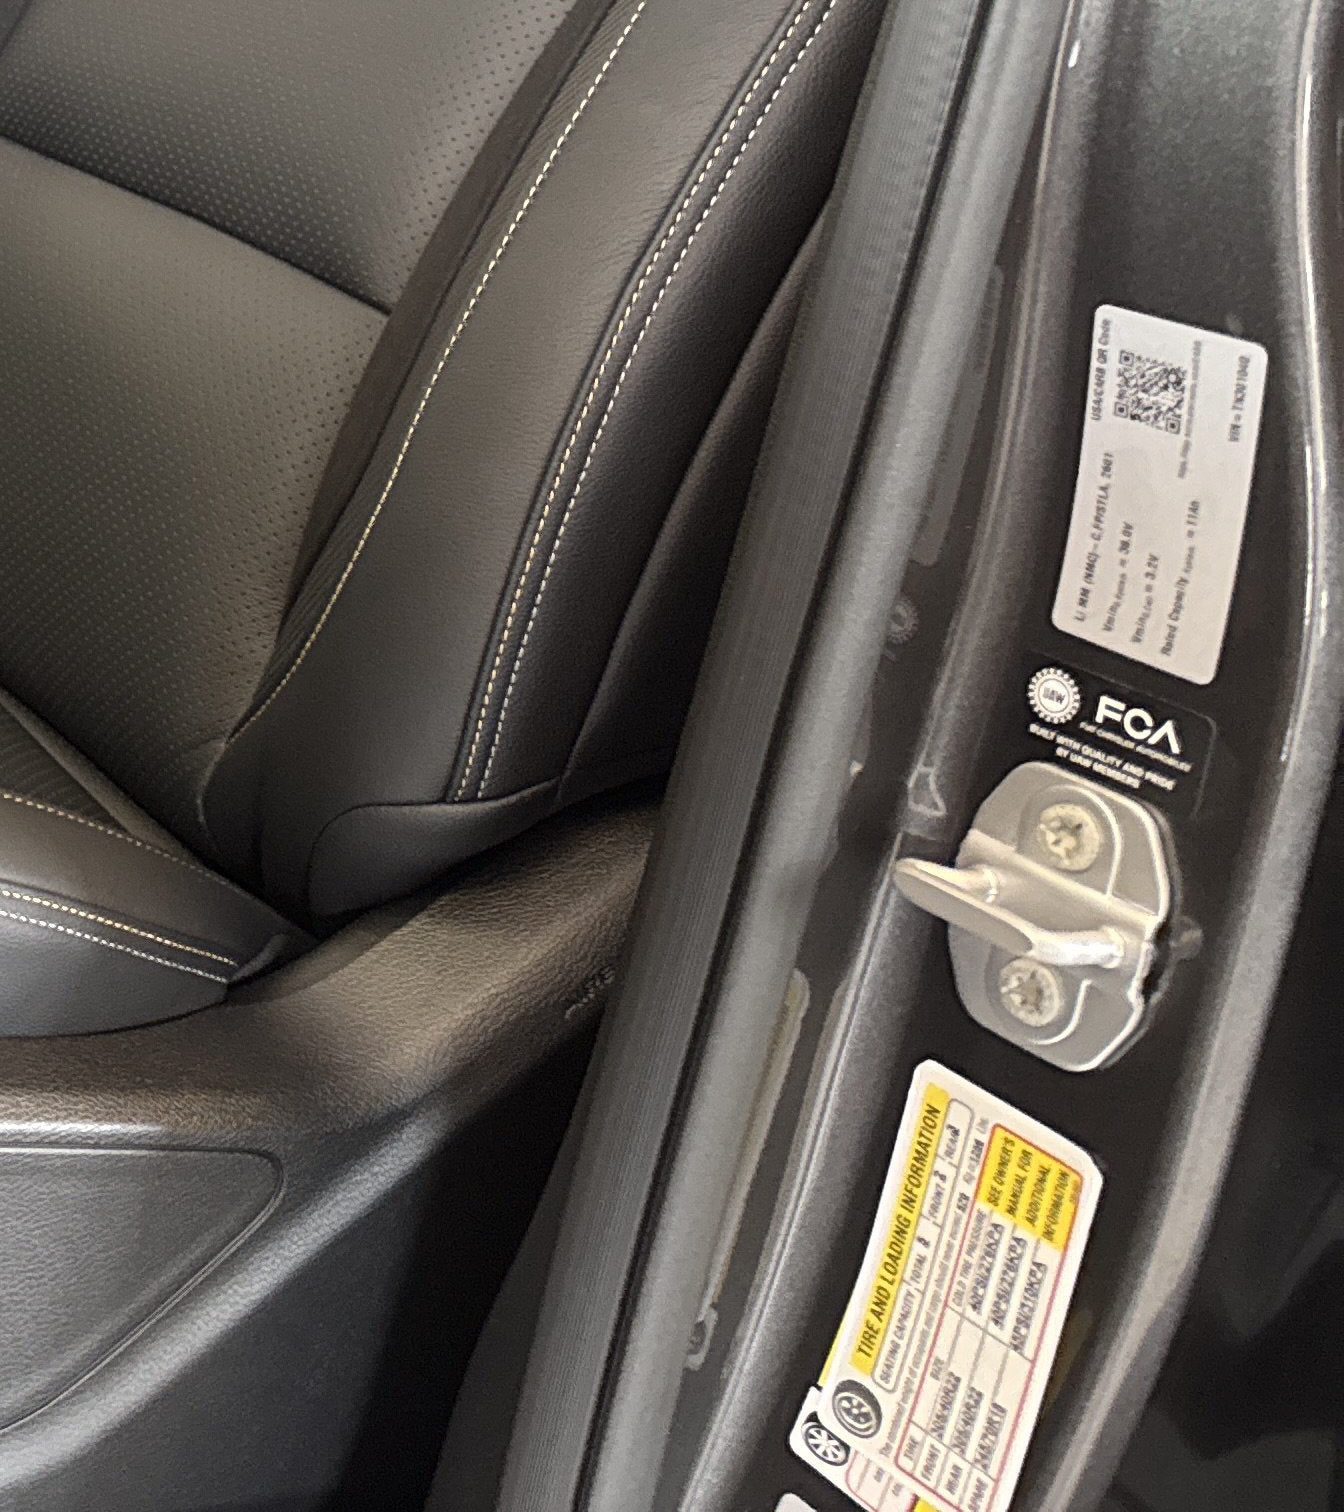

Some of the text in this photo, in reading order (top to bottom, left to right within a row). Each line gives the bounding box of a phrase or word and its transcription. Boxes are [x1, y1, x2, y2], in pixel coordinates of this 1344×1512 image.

[1098, 319, 1111, 346] Code
[1168, 576, 1189, 622] Capacity
[1160, 624, 1178, 656] Rated
[1095, 695, 1181, 754] FCA
[944, 1130, 960, 1159] REAR
[987, 1136, 1015, 1207] SEE OWNER'S
[1006, 1149, 1033, 1217] MANUAL FOR
[1025, 1165, 1051, 1227] ADDITIONAL
[928, 1183, 945, 1219] FRONT
[1042, 1169, 1070, 1242] INFORMATION
[857, 1103, 941, 1358] TIRE AND LOADING INFORMATION
[910, 1254, 927, 1284] TOTAL
[879, 1340, 901, 1384] SEATING
[893, 1290, 915, 1340] CAPACITY
[921, 1444, 940, 1481] FRONT
